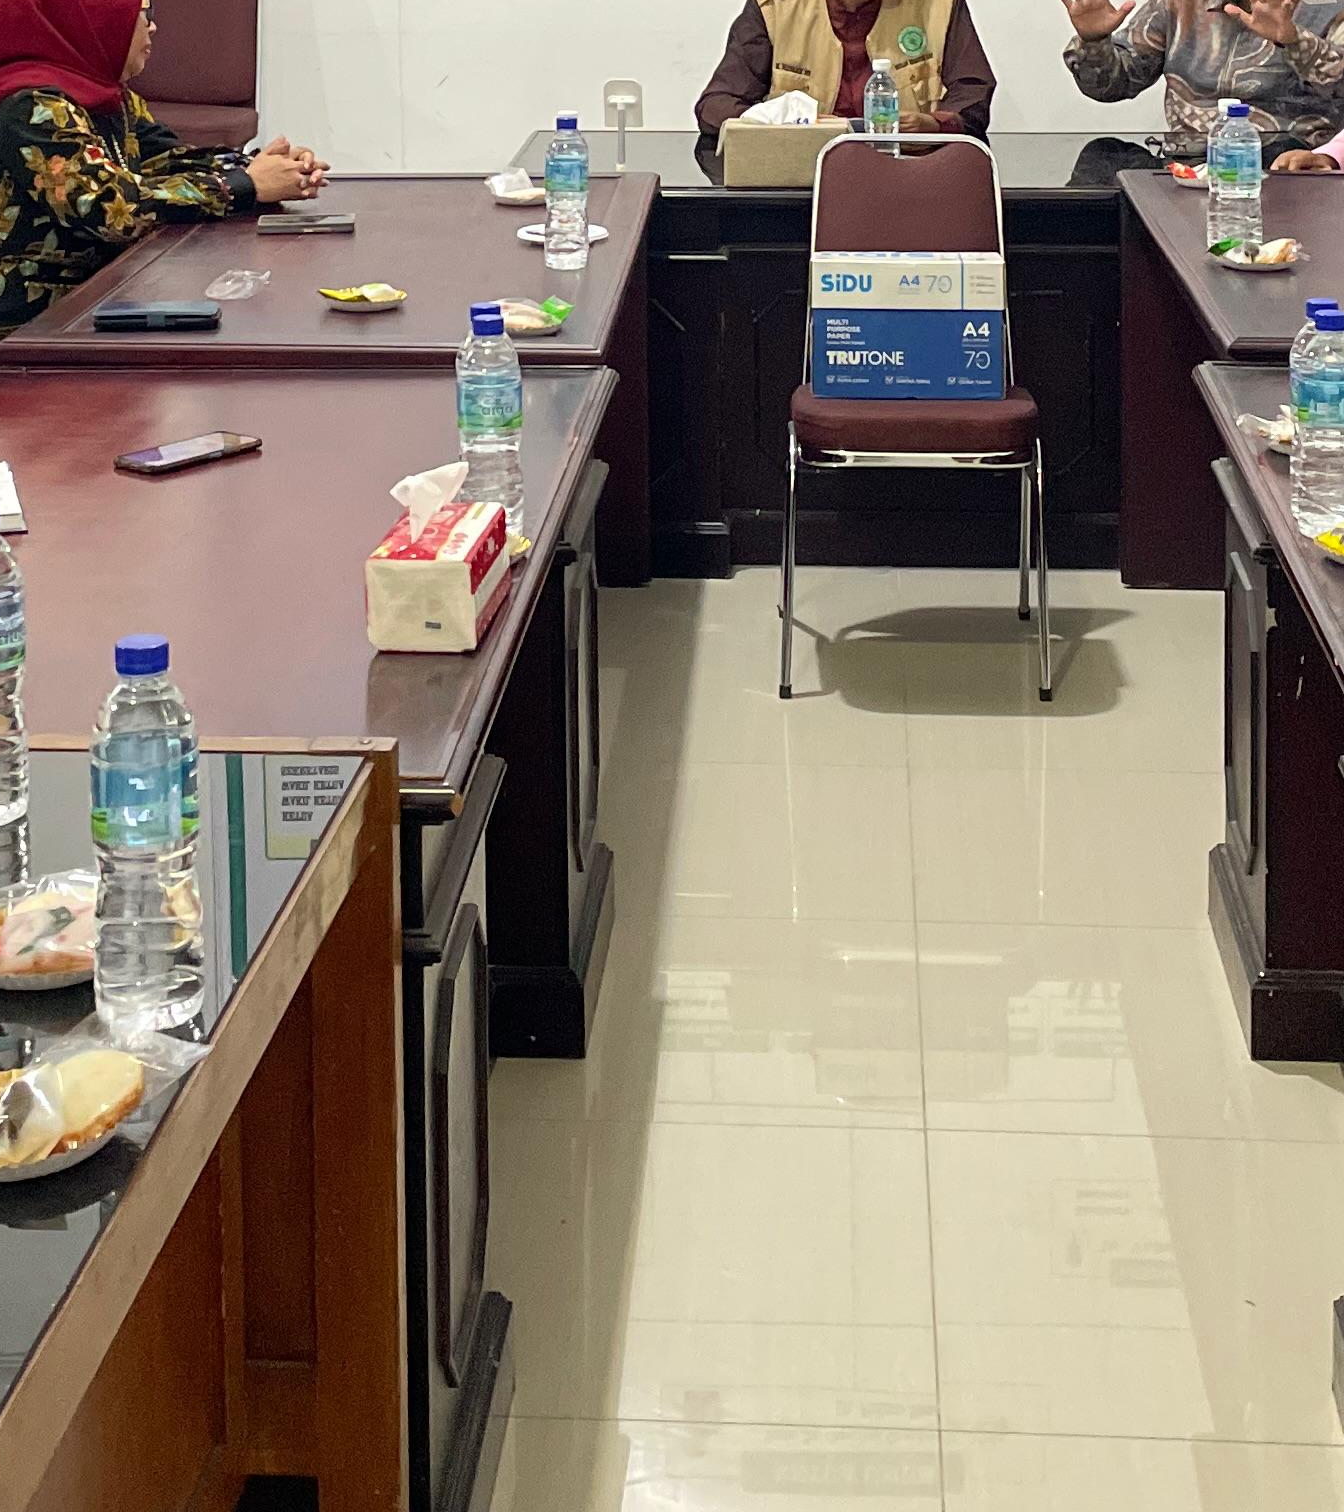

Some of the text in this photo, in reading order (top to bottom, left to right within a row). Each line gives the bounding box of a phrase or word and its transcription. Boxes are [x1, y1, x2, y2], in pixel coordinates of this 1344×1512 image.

[820, 274, 872, 293] SiDU
[899, 275, 921, 286] A4
[925, 275, 952, 294] 70
[963, 322, 991, 337] A4
[826, 350, 905, 366] TRUTONE
[964, 350, 991, 369] 70
